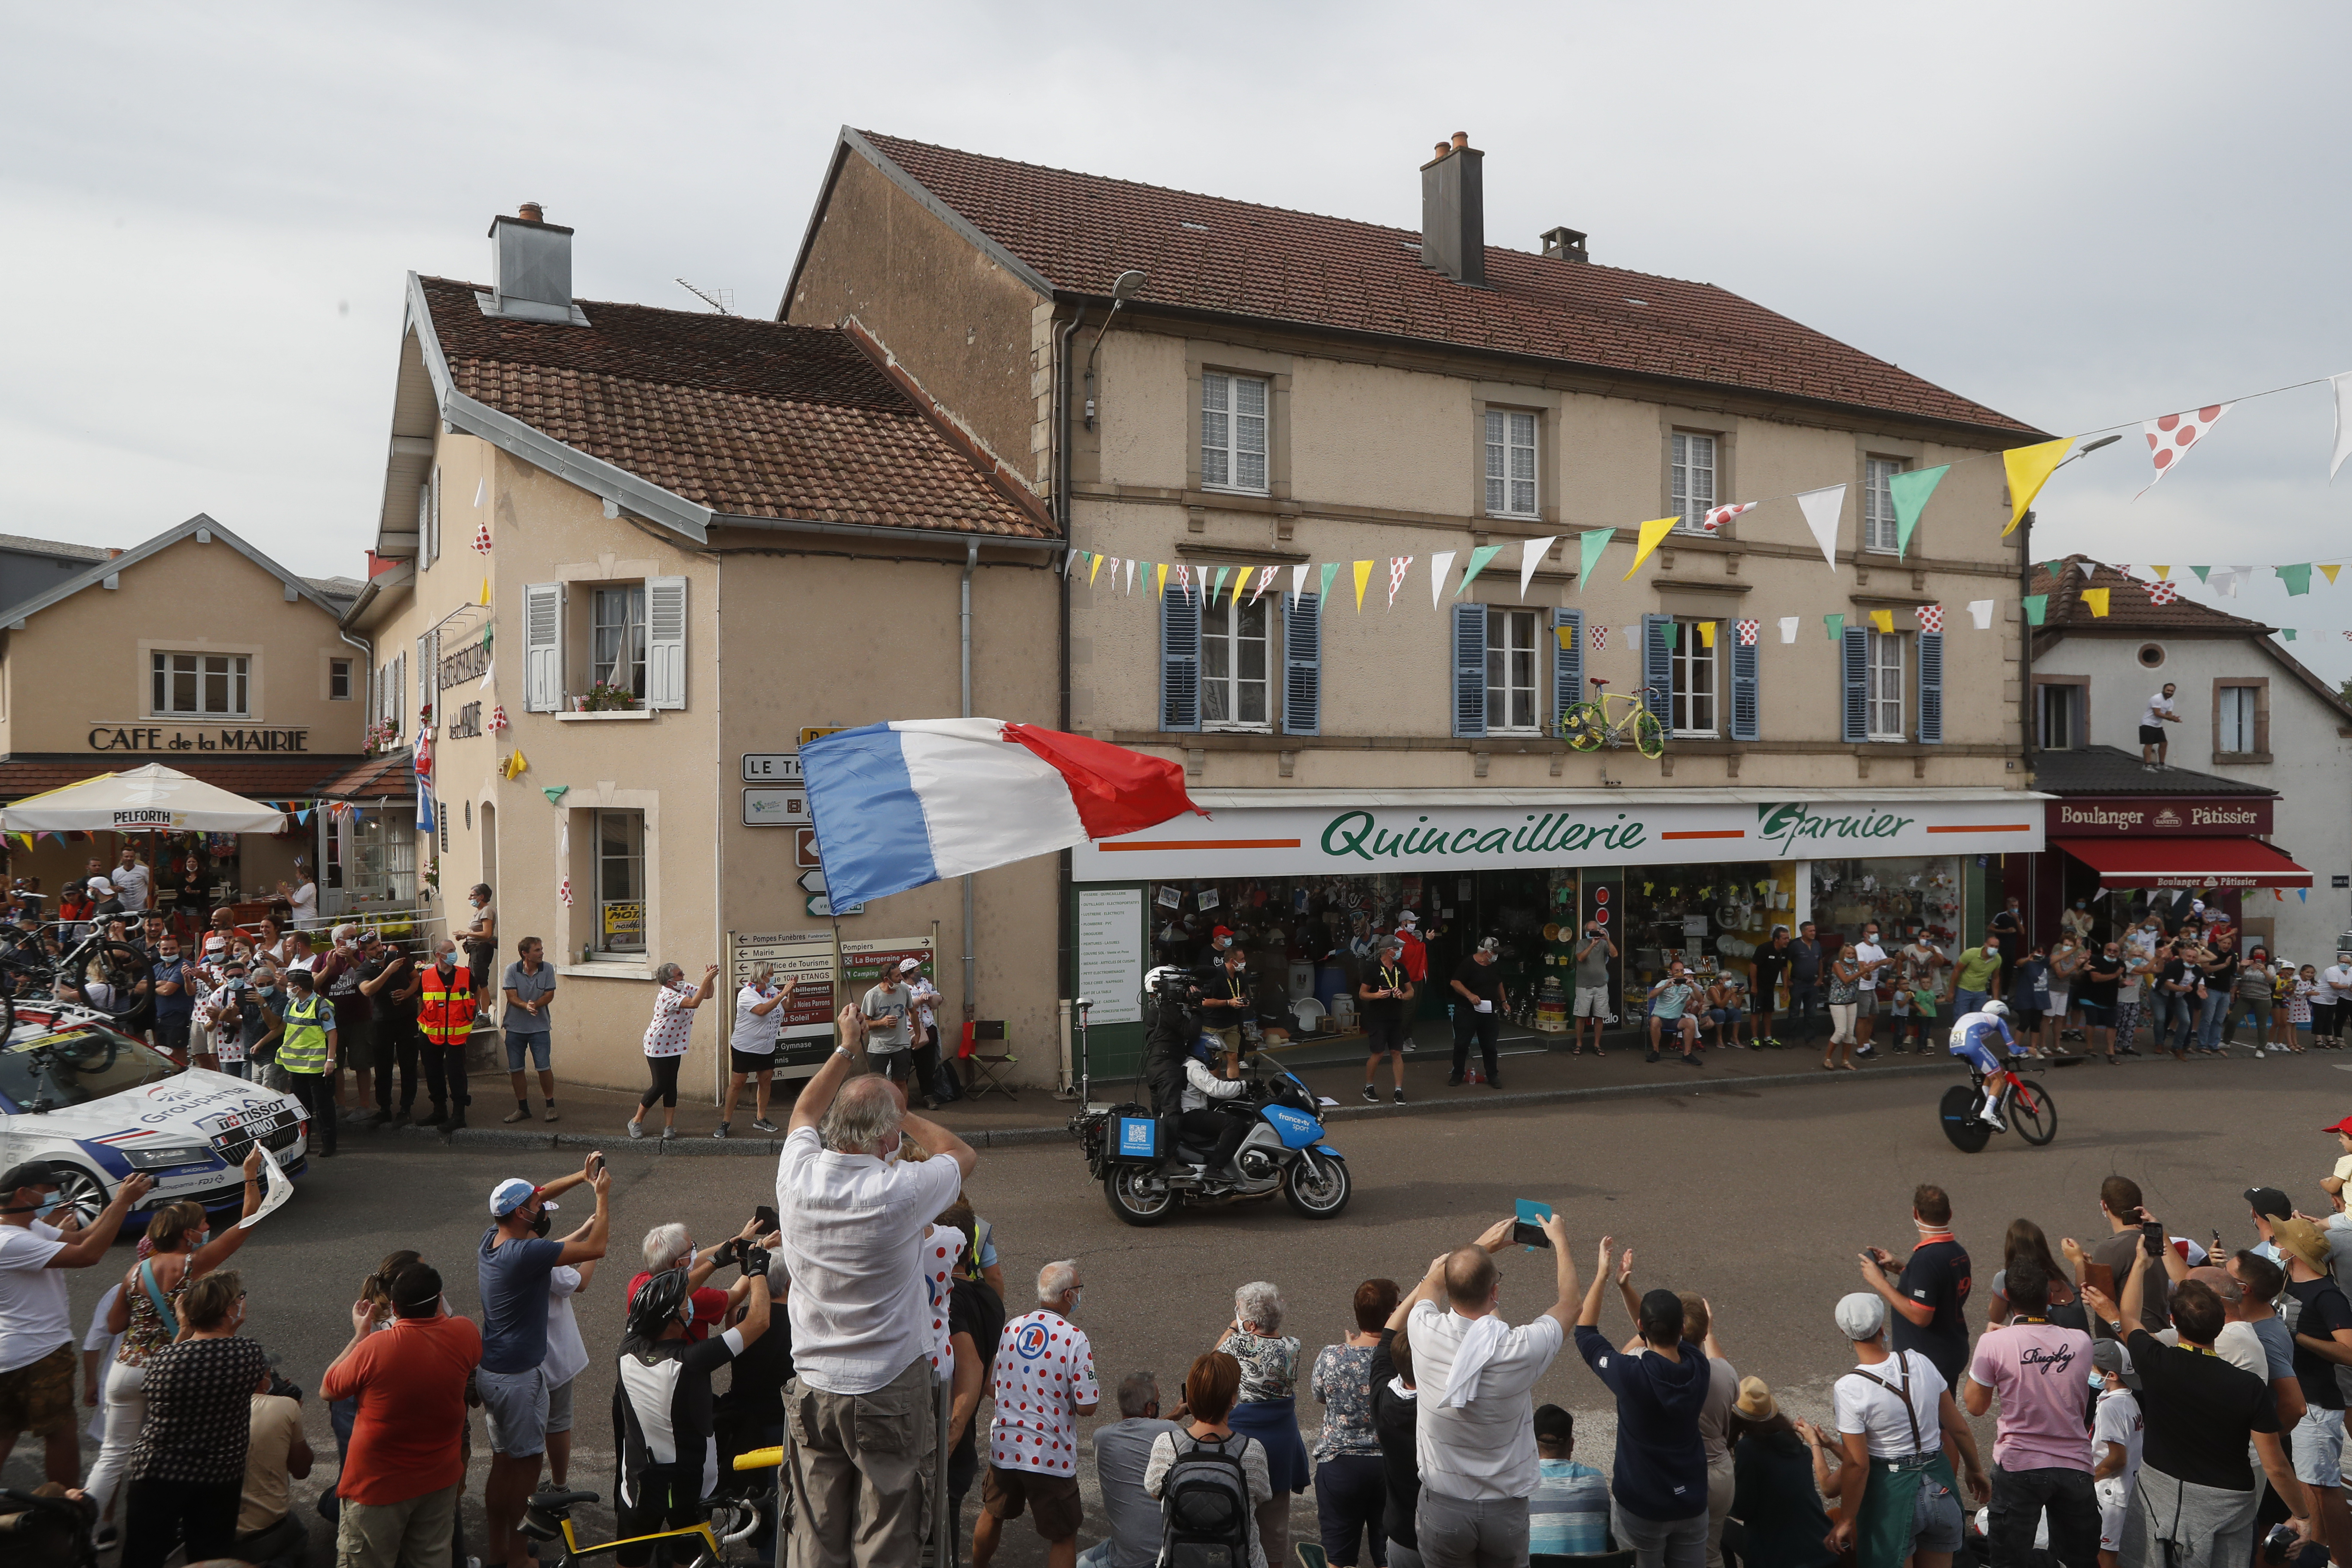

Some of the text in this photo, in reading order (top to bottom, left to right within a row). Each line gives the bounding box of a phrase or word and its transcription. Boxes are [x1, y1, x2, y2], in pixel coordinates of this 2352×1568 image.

[89, 728, 308, 751] CAFE de la MAIRIE
[751, 761, 772, 774] LE
[114, 810, 170, 824] PELFORTH
[2061, 806, 2144, 830] Boulanger
[2191, 807, 2257, 825] Pâtissier
[1321, 802, 1914, 861] Quincaillerie Garnier
[2157, 878, 2201, 887] Boulanger
[2220, 878, 2257, 886] Pâtissier
[753, 949, 774, 957] Mairie
[865, 955, 900, 964] Bergeraine
[801, 972, 830, 980] ETANGS
[790, 1014, 809, 1022] Soleil
[879, 1003, 905, 1020] 73
[1953, 1032, 1962, 1042] 51
[781, 1041, 812, 1051] Gymnase
[140, 1087, 250, 1123] Groupama
[237, 1099, 288, 1123] TISSOT
[10, 1126, 82, 1138] LAPIERRE
[245, 1116, 279, 1137] PINOT
[1292, 1124, 1310, 1133] sport
[158, 1178, 213, 1191] Groupama FDJ
[662, 1304, 675, 1319] MET
[2020, 1343, 2075, 1375] Rugby
